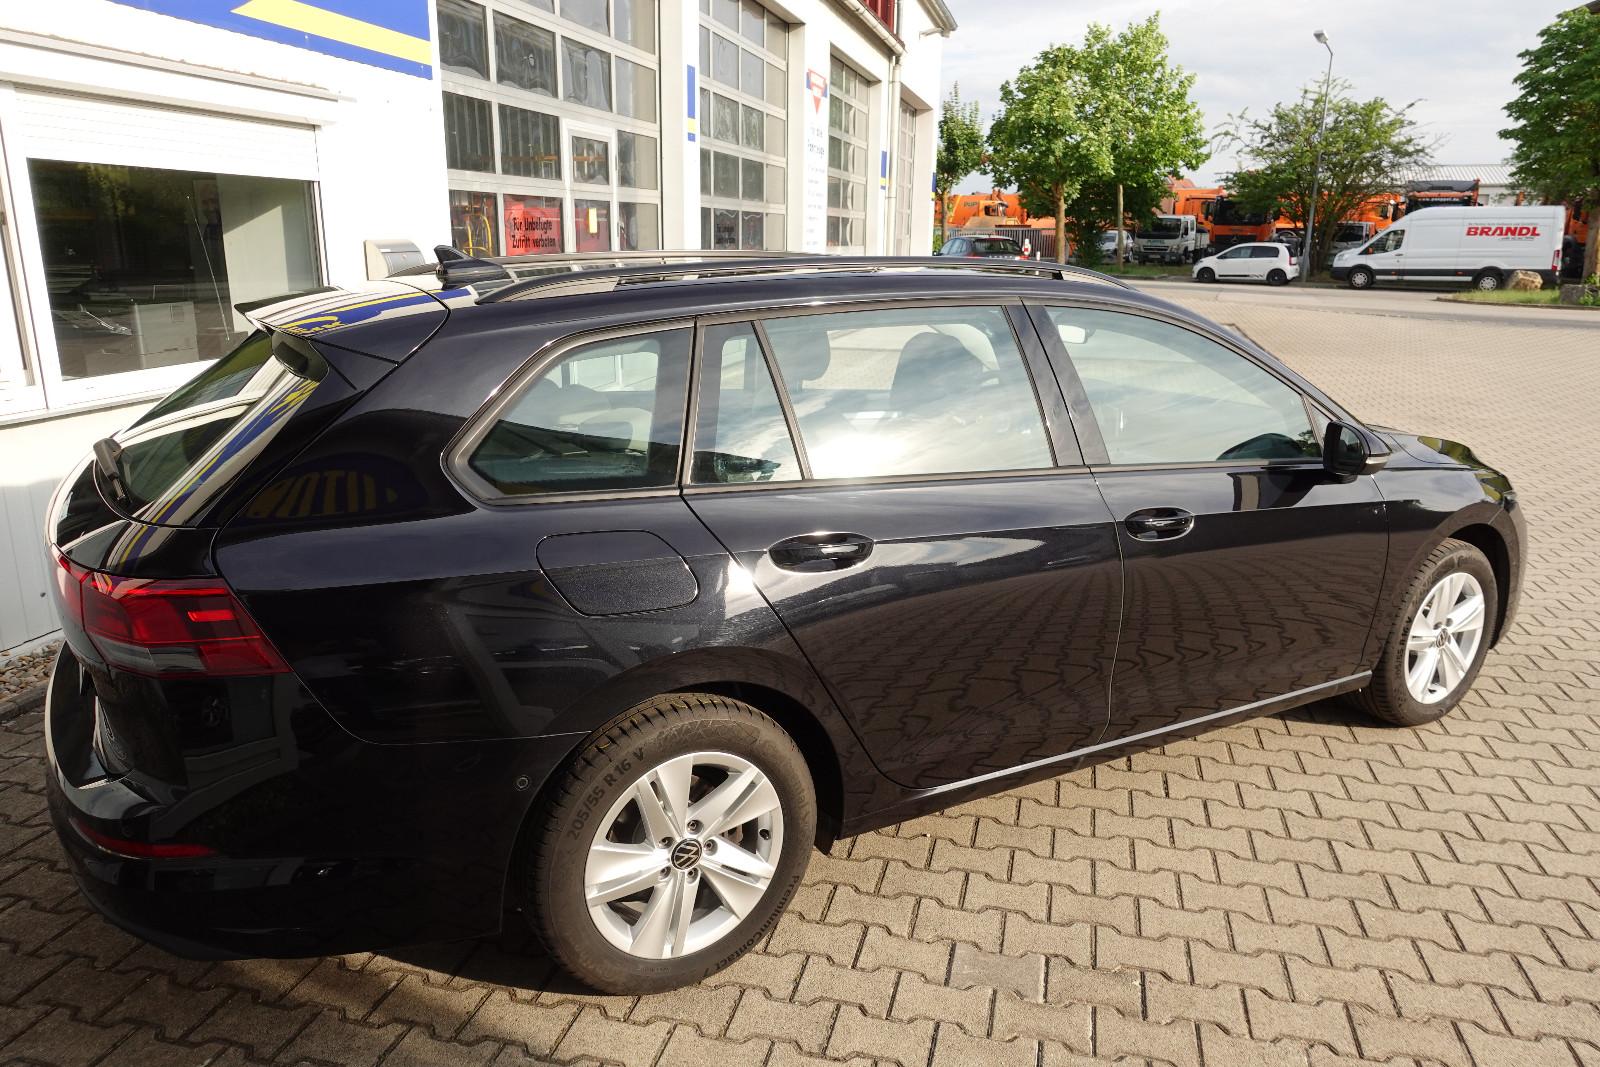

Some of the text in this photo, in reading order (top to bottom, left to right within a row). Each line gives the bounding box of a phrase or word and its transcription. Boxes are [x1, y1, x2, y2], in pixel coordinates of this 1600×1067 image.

[525, 217, 552, 234] Unbefugte
[1466, 226, 1540, 236] BRANDL
[512, 234, 556, 248] Zutritt verboten
[567, 747, 645, 840] 205/55 R 16 V
[714, 875, 800, 972] PremiumContact
